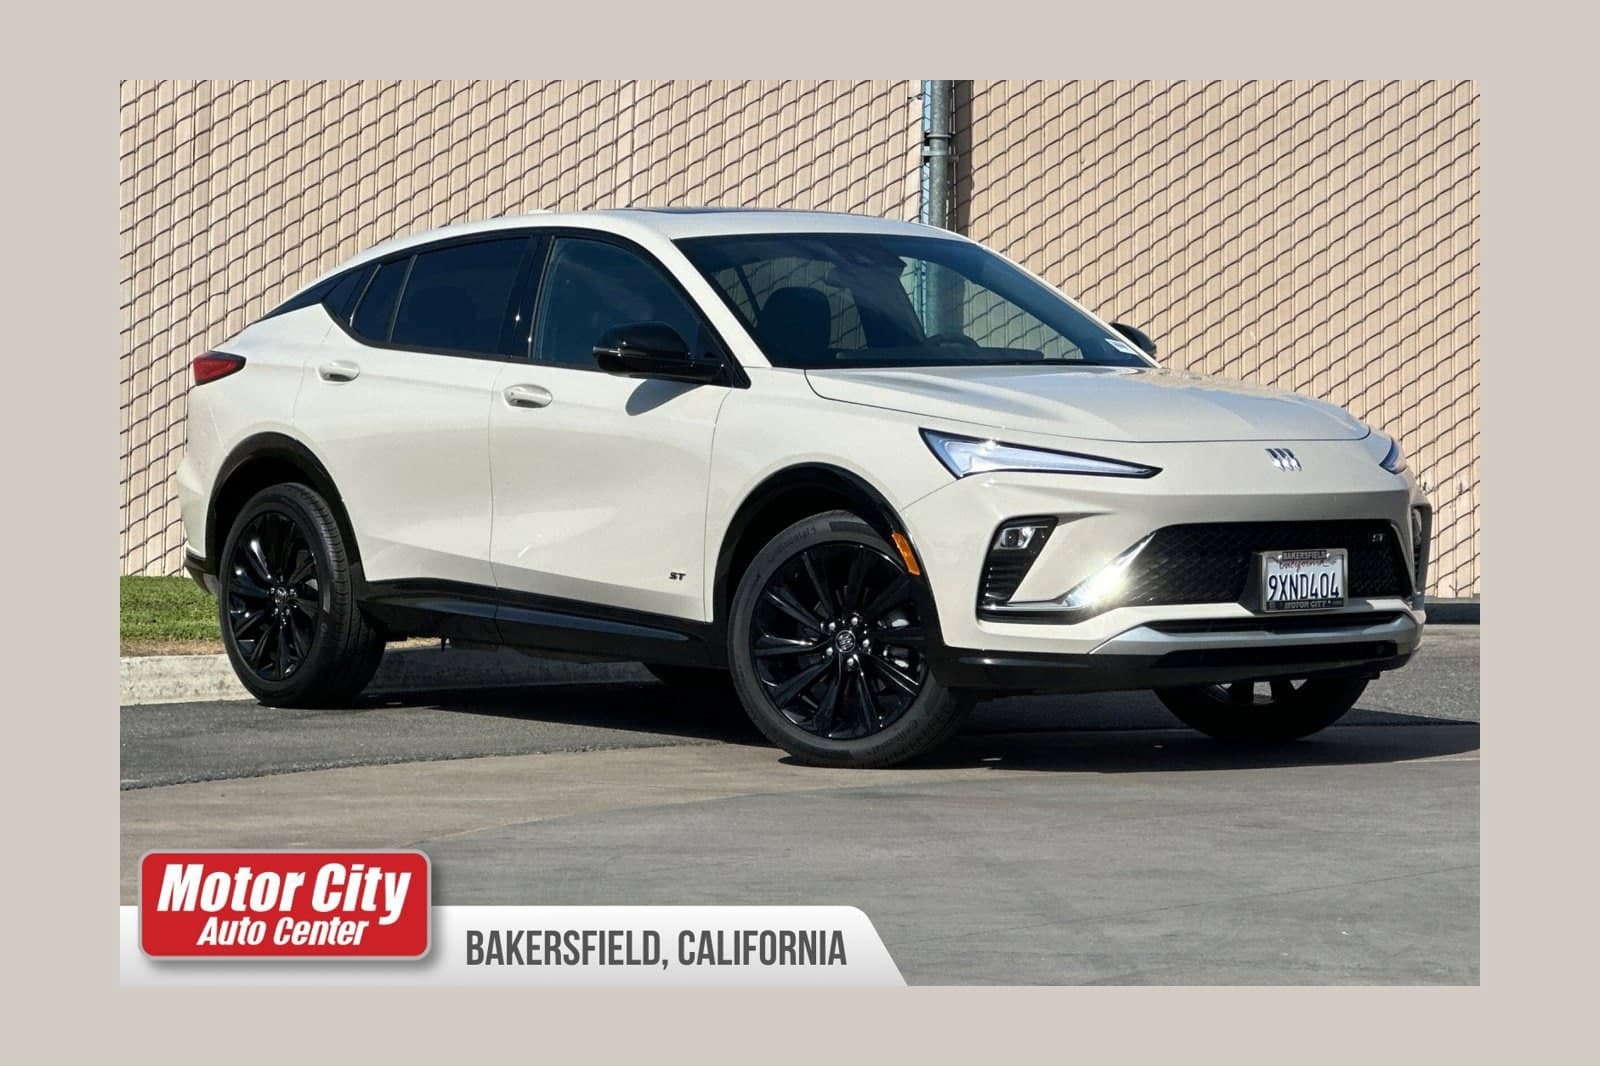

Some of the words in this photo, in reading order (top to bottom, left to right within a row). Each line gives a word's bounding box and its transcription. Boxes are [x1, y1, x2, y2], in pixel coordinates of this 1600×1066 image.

[1282, 551, 1327, 560] BAKERSFIELD
[668, 571, 686, 581] ST
[1268, 573, 1339, 601] 9XND404
